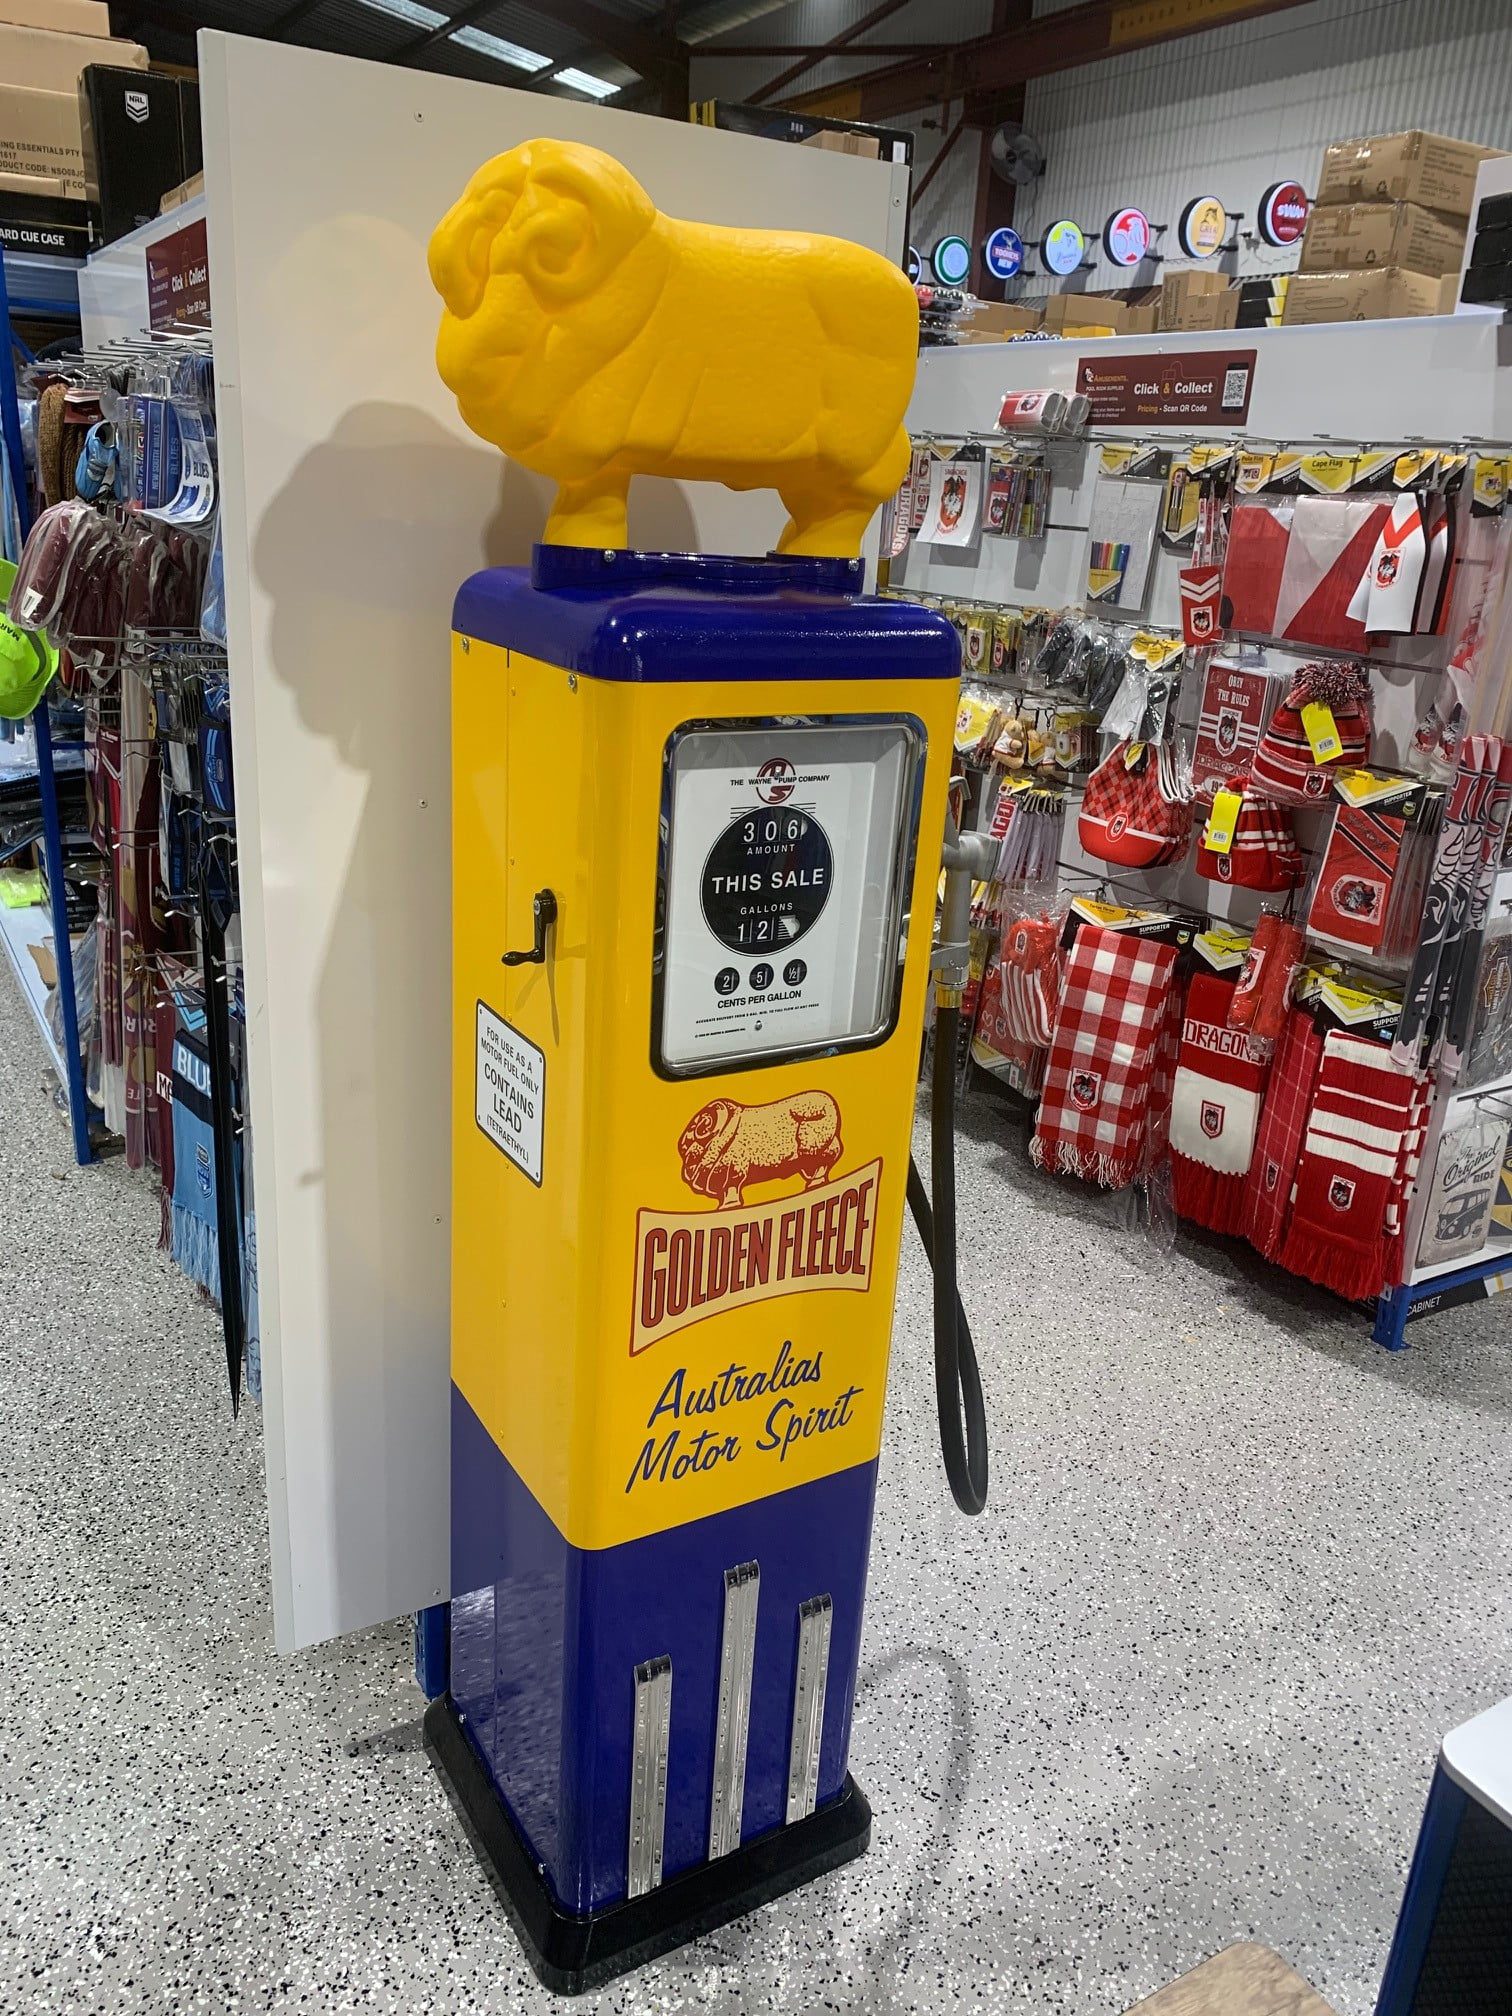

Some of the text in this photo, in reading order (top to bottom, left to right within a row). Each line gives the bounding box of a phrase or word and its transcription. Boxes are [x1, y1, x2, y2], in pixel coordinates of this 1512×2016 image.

[128, 95, 145, 104] NRL
[16, 143, 64, 156] ESSENTIALS
[66, 149, 80, 157] PTY
[20, 231, 40, 243] CUE
[40, 232, 65, 246] CASE
[994, 247, 1020, 261] TOOHEYS
[1134, 382, 1213, 395] Click & Collect
[1137, 404, 1158, 414] Pricing
[1163, 404, 1178, 412] Scan
[1180, 404, 1190, 413] QR
[1192, 404, 1208, 412] Code
[194, 461, 210, 478] BLUES
[1312, 459, 1344, 468] Cape Flag
[1368, 462, 1396, 483] SUPPORTER
[0, 623, 20, 642] MAR
[1228, 674, 1244, 689] OBEY
[1218, 688, 1250, 707] THE RULES
[798, 774, 830, 782] COMPANY
[1384, 790, 1412, 806] SUPPORTER
[746, 844, 796, 856] AMOUNT
[712, 868, 824, 894] THIS SALE
[740, 902, 794, 915] GALLONS
[1139, 924, 1170, 934] SUPPORTER
[722, 976, 730, 988] 2
[756, 971, 764, 984] 5
[718, 990, 802, 1008] CENTS PER GALLON
[1184, 1020, 1256, 1062] DRAGON
[487, 1026, 532, 1074] FOR USE AS A
[481, 1038, 540, 1095] MOTOR FUEL ONLY
[484, 1062, 534, 1120] CONTAINS
[494, 1093, 522, 1134] LEAD
[486, 1114, 529, 1164] (TETRAETHYL)
[1444, 1135, 1501, 1188] Original
[1457, 1147, 1474, 1162] The
[1472, 1170, 1496, 1184] RIDE
[640, 1178, 874, 1328] GOLDEN FLEECE
[1406, 1295, 1442, 1317] CABINET
[646, 1340, 824, 1429] Australias
[624, 1386, 865, 1494] Motor Spirit
